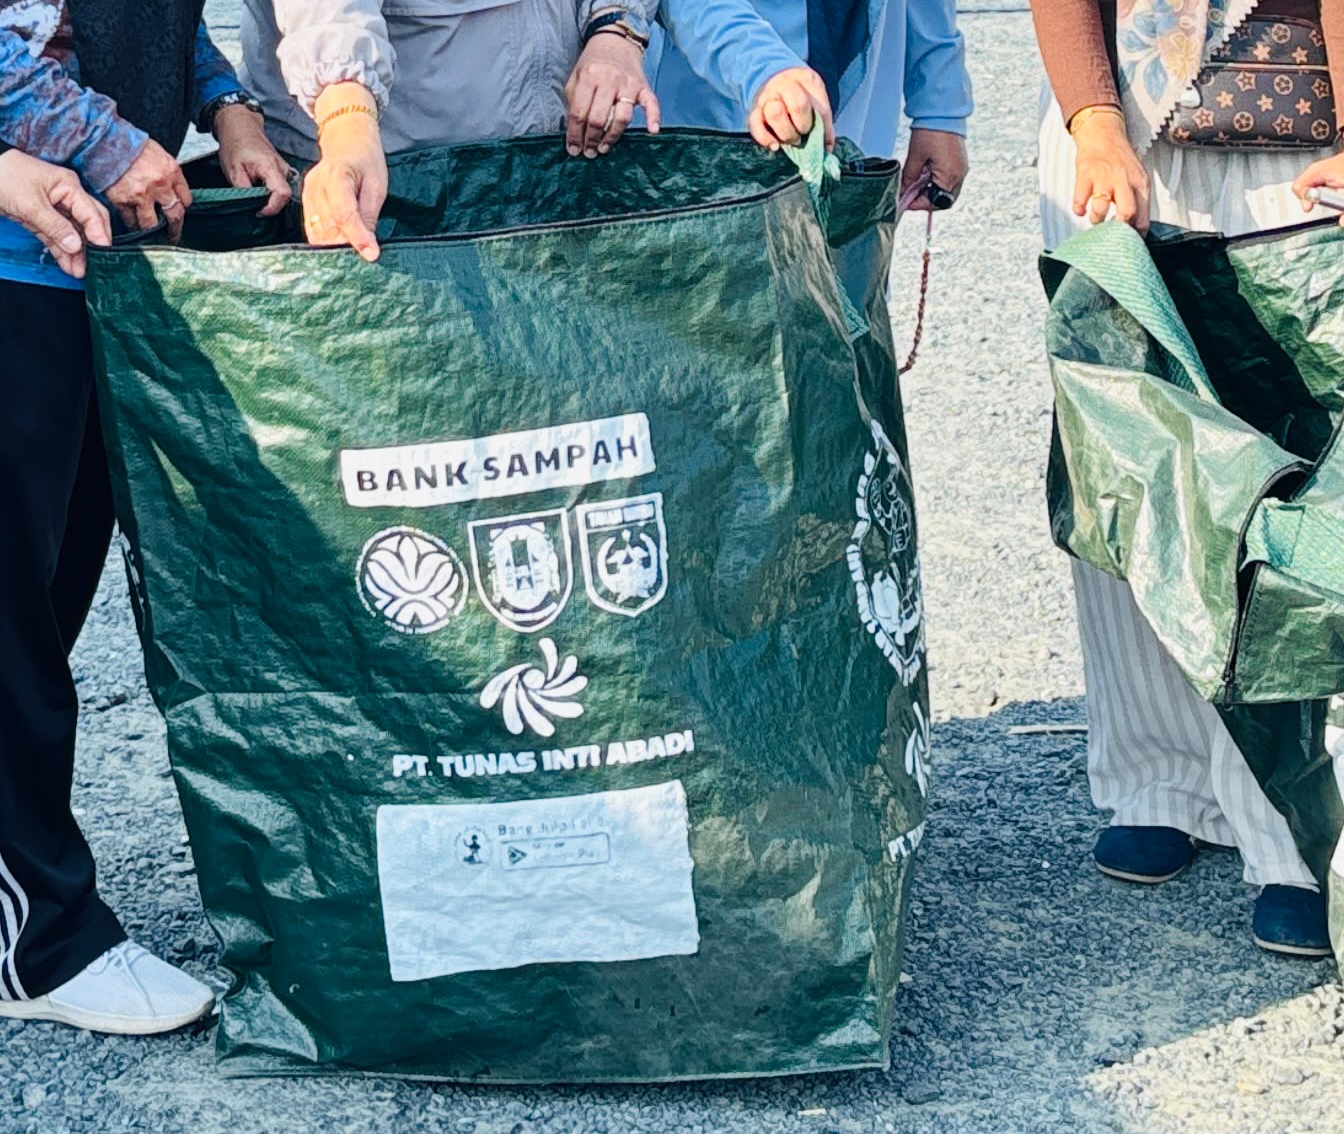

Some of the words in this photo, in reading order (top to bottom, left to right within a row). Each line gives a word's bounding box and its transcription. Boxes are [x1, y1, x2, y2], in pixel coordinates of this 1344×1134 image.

[356, 461, 469, 492] BANK
[483, 435, 638, 481] SAMPAH
[393, 753, 433, 778] PT.
[436, 751, 536, 778] TUNAS
[541, 744, 602, 772] INTI
[605, 730, 695, 766] ABADI
